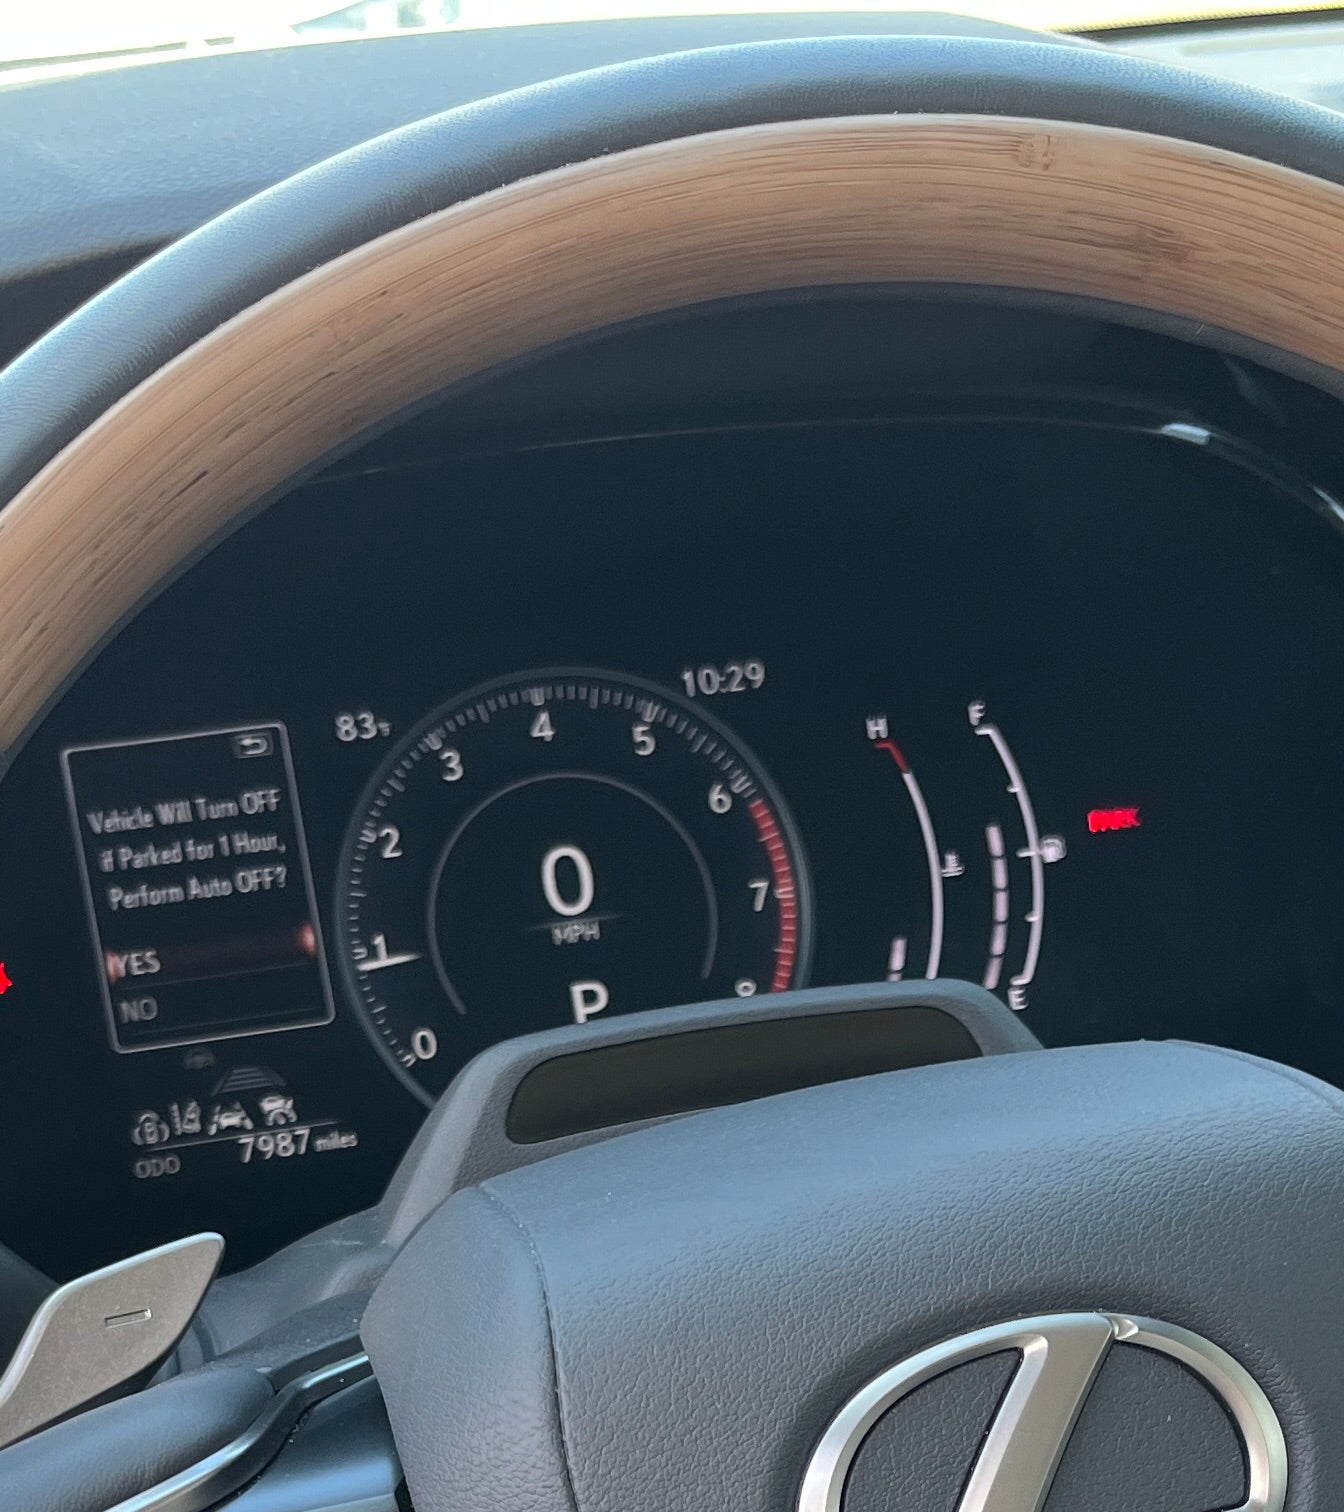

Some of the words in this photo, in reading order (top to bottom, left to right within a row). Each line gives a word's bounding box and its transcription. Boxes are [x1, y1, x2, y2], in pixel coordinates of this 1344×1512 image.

[681, 659, 765, 697] 10:29
[530, 711, 555, 742] 4
[866, 714, 889, 740] H
[968, 700, 986, 726] F
[632, 723, 656, 756] 5
[440, 749, 464, 782] 3
[86, 806, 154, 834] Vehicle
[155, 799, 193, 825] Will
[194, 796, 239, 820] Turn
[239, 788, 281, 815] OFF
[708, 782, 733, 814] 6
[116, 840, 183, 871] Parked
[184, 837, 215, 863] for
[219, 833, 230, 857] 1
[377, 825, 404, 859] 2
[109, 882, 185, 911] Perform
[186, 874, 233, 903] Auto
[234, 864, 288, 895] OFF?
[541, 844, 595, 917] 0
[748, 879, 769, 912] 7
[370, 932, 390, 960] 1
[551, 920, 600, 945] MPH
[118, 950, 161, 977] YES
[119, 998, 158, 1024] NO
[569, 979, 609, 1024] P
[1008, 984, 1029, 1011] E
[411, 1026, 438, 1060] 0
[133, 1154, 181, 1179] ODO
[236, 1129, 311, 1164] 7987
[314, 1131, 358, 1152] miles
